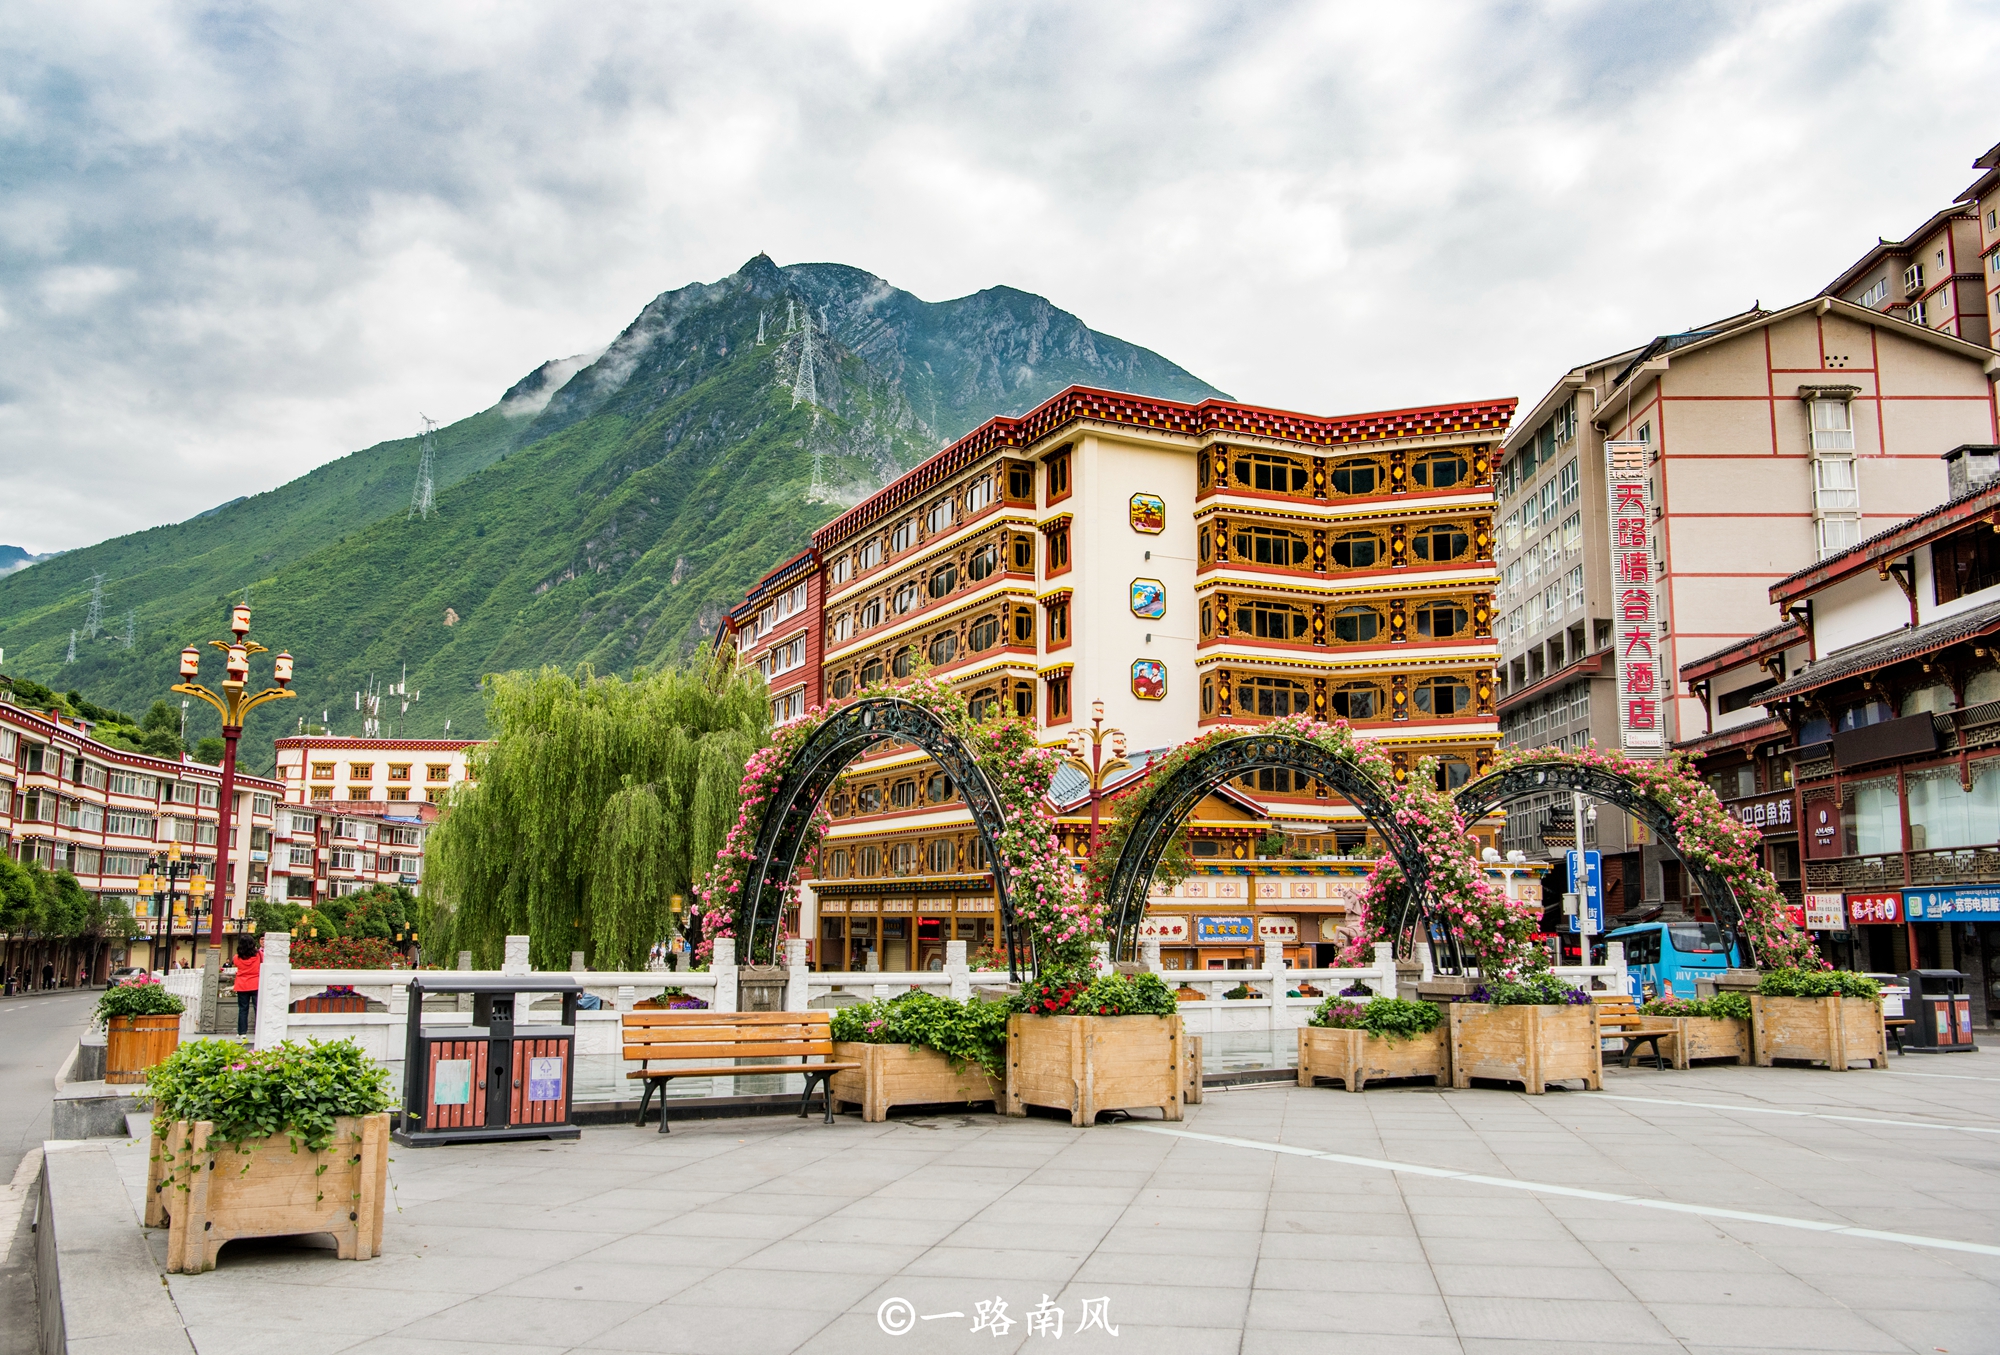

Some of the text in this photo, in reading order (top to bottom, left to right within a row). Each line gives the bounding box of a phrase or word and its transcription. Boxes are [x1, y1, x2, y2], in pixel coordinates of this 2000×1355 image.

[1616, 484, 1656, 730] 天路情谷大酒店
[1955, 897, 2000, 912] 宽带电视服
